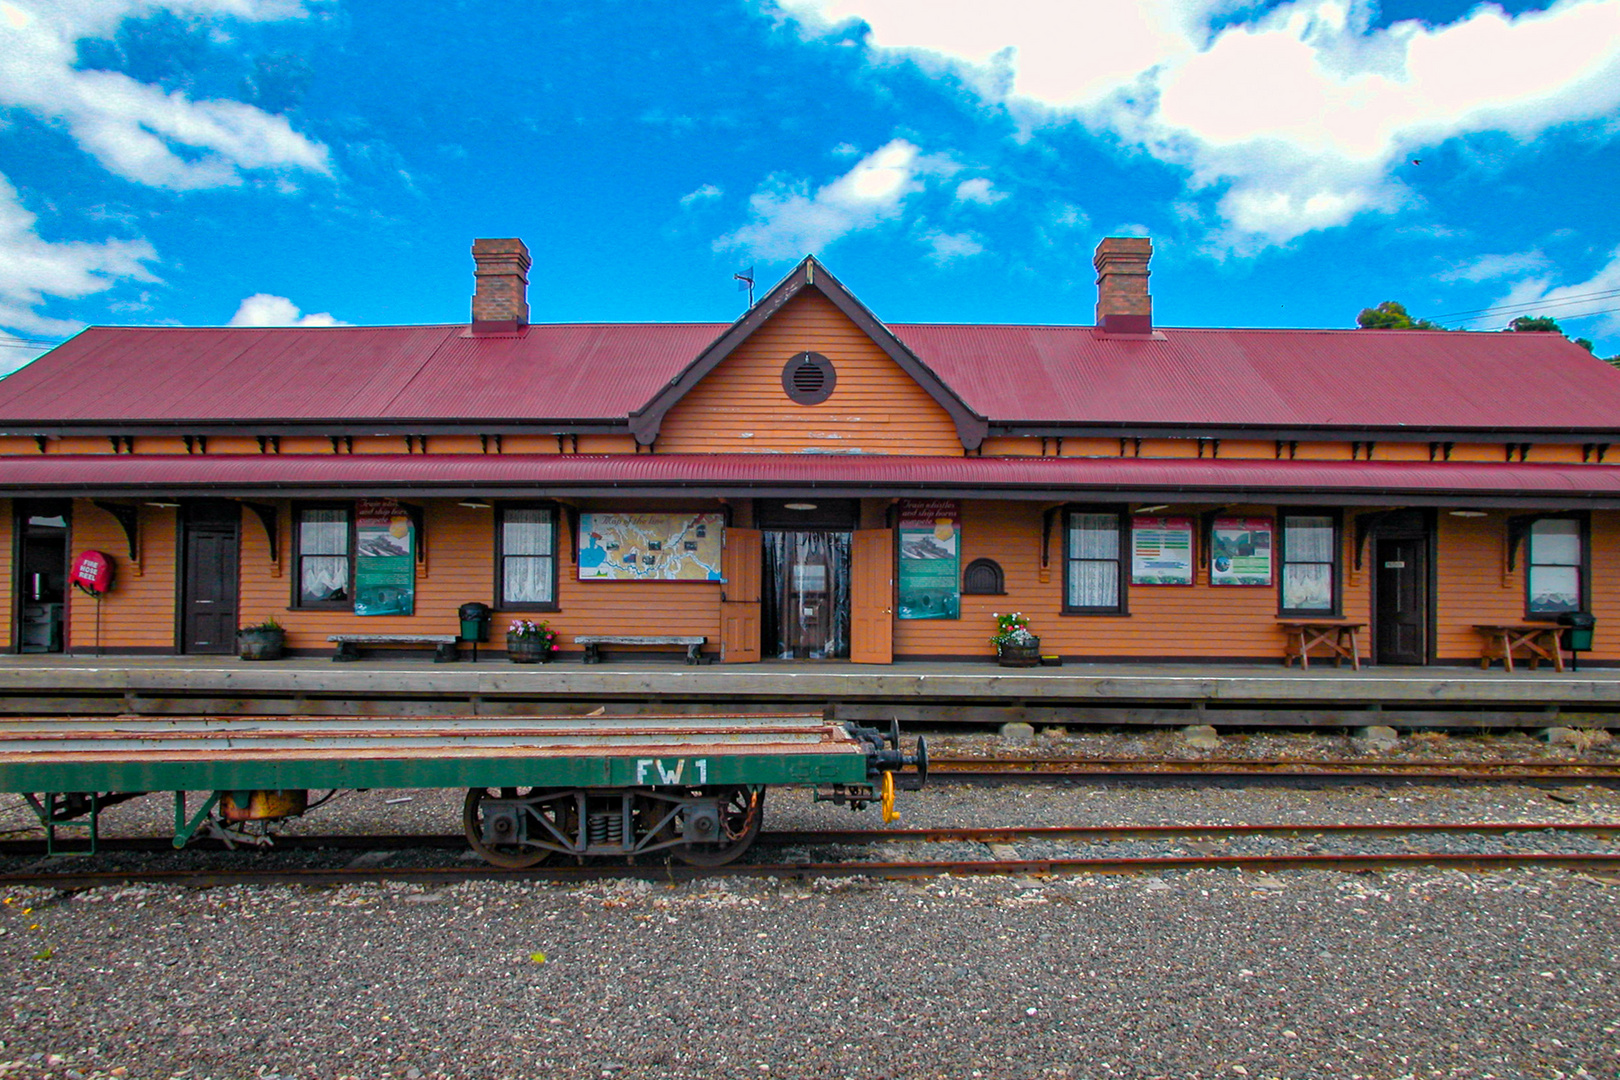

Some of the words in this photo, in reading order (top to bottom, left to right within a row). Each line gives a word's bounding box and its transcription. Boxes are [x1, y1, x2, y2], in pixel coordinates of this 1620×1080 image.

[903, 499, 924, 508] Train
[925, 500, 955, 508] whistles
[918, 509, 934, 519] ship
[601, 515, 622, 526] Map
[624, 515, 634, 528] of
[633, 515, 647, 525] the
[648, 515, 665, 525] line
[902, 518, 933, 527] compete
[83, 559, 98, 569] FIRE
[80, 565, 98, 575] HOSE
[78, 571, 96, 581] REEL
[637, 759, 685, 785] FW
[695, 759, 707, 784] 1
